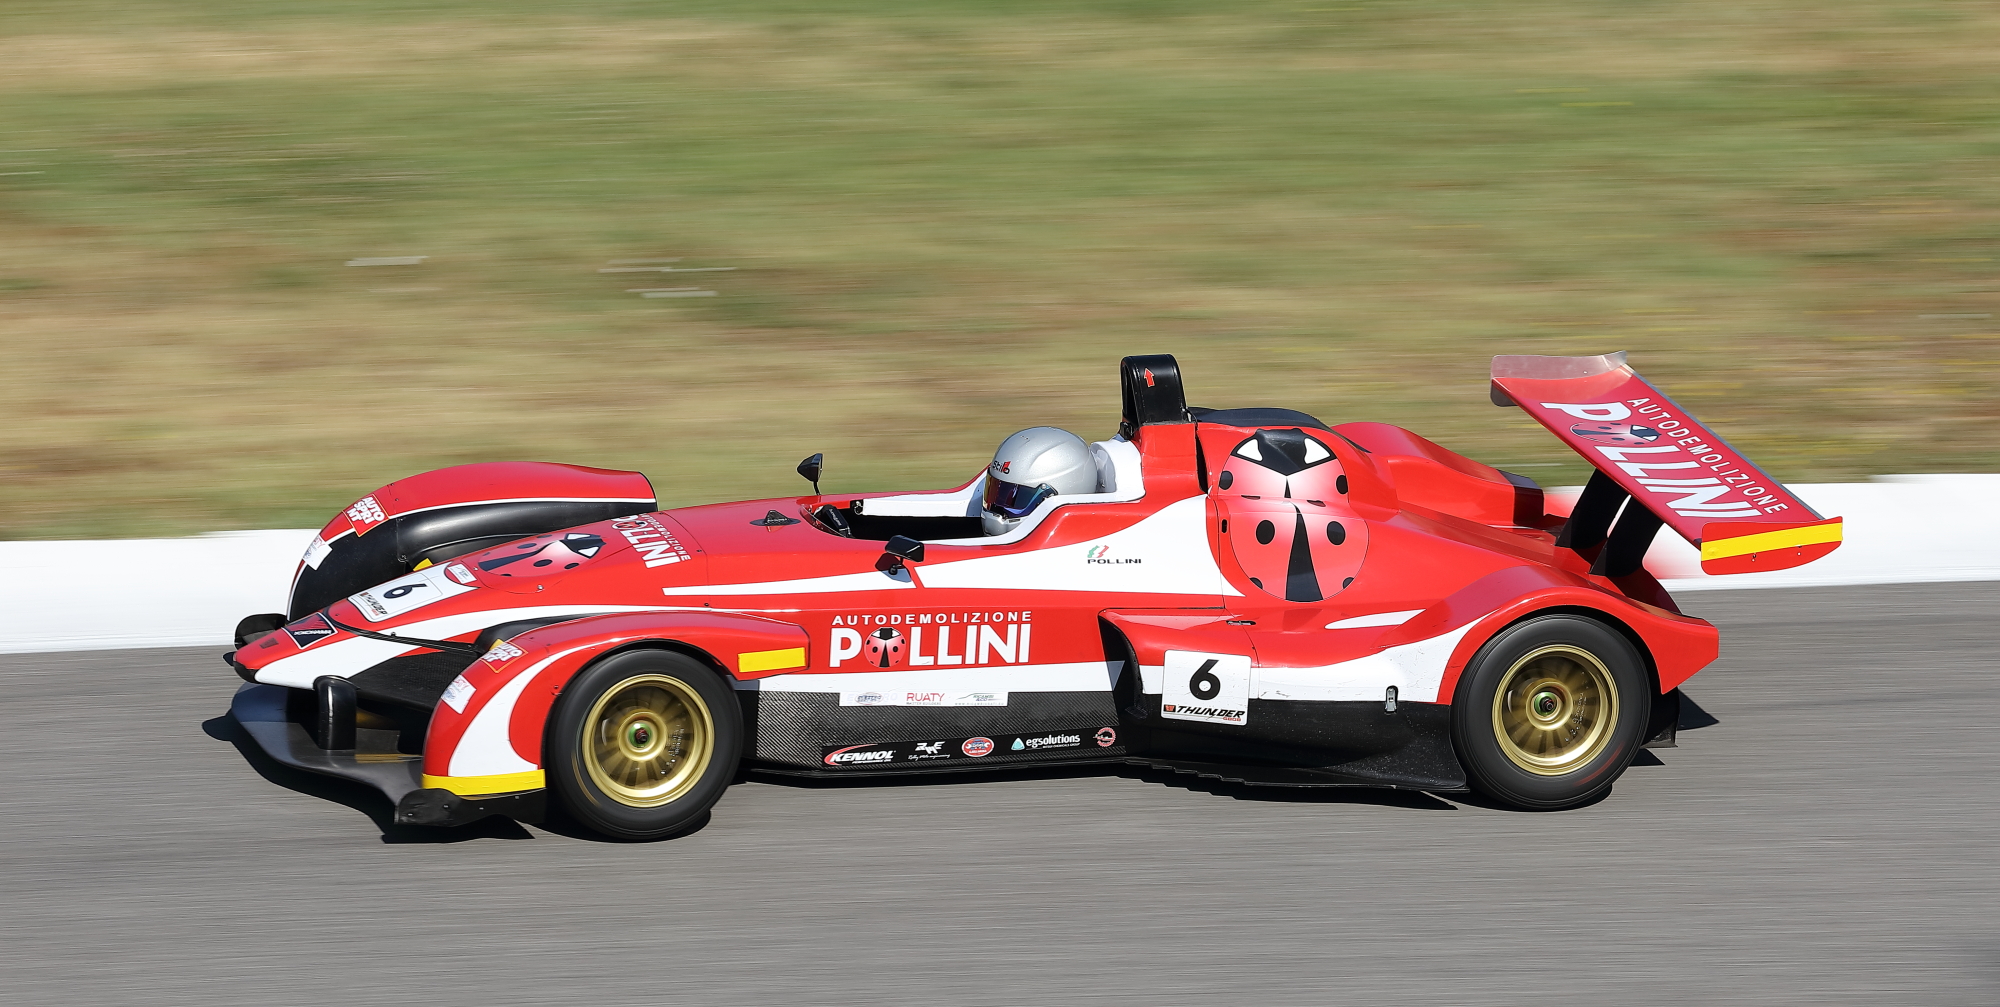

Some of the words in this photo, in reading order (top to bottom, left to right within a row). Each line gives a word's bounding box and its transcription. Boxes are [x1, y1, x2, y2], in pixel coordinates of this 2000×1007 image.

[1540, 401, 1763, 517] POLLINI
[1627, 397, 1789, 514] AUTODEMOLIZIONE
[993, 461, 1011, 475] Stilo
[361, 496, 385, 522] AUTO
[383, 583, 429, 599] 6
[831, 611, 1032, 626] AUTODEMOLIZIONE
[829, 623, 1032, 668] POLLINI
[1189, 659, 1221, 701] 6
[906, 692, 946, 702] RUATY
[1177, 705, 1246, 718] THUNDER
[1025, 734, 1081, 749] egsolutions
